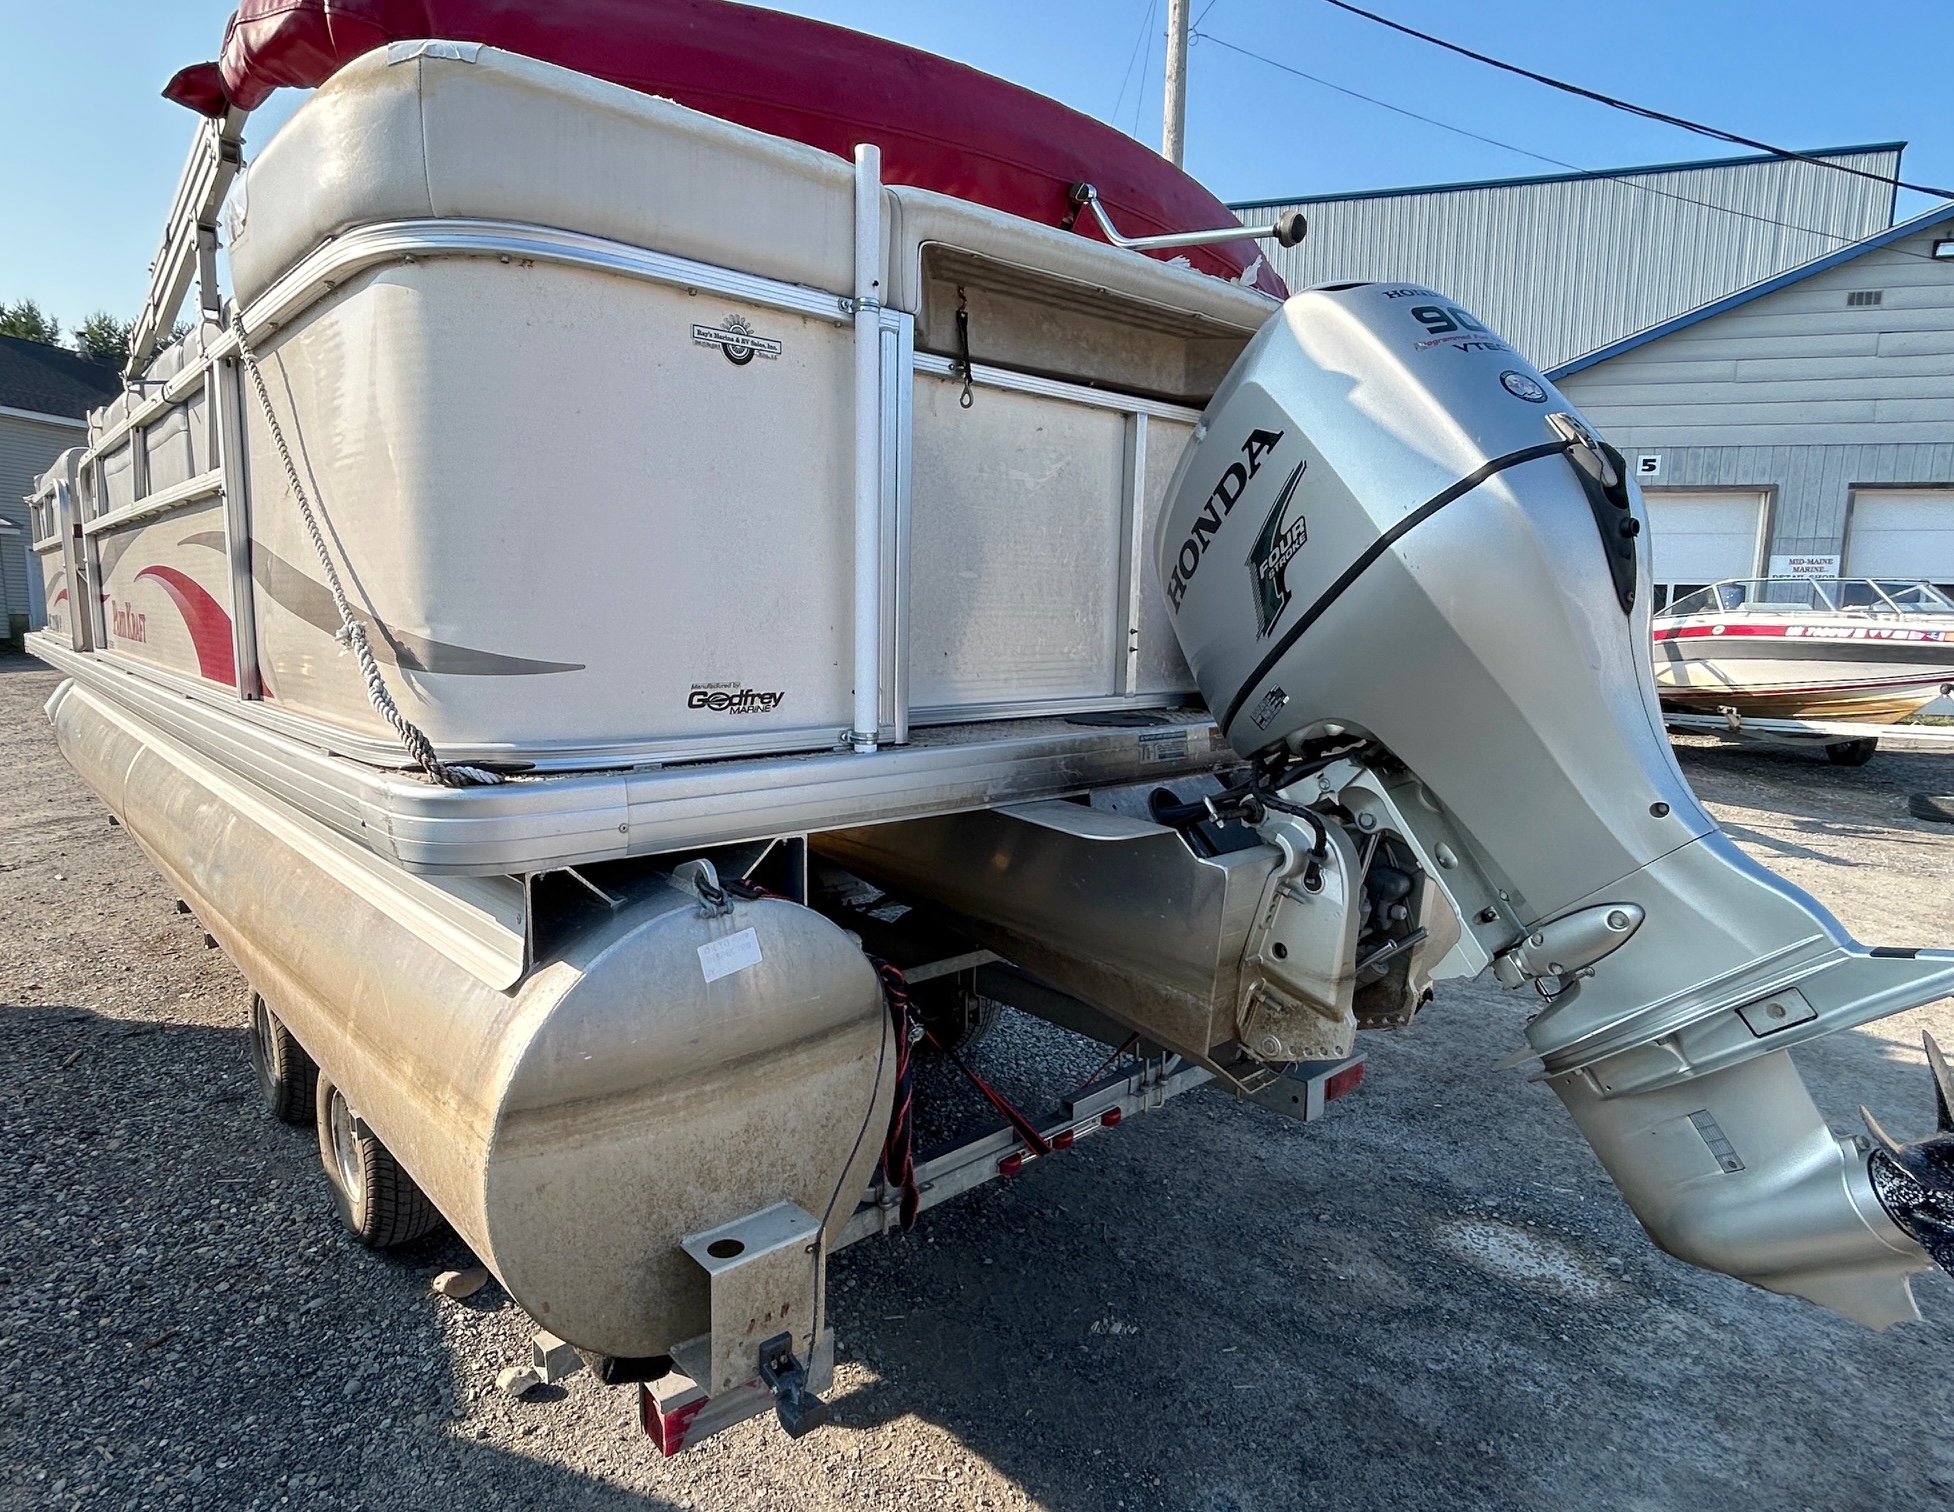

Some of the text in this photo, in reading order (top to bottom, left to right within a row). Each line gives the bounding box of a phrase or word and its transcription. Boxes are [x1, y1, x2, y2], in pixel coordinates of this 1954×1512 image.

[1411, 306, 1490, 334] 90
[1414, 334, 1471, 351] ogrammed
[1452, 342, 1511, 353] VTEC
[1641, 458, 1657, 472] 5
[1167, 428, 1284, 615] HONDA
[1259, 516, 1306, 580] FOUR
[1268, 532, 1306, 580] STROKE
[1789, 558, 1834, 566] MID-MAINE
[687, 688, 786, 712] Godfrey
[729, 704, 772, 715] MARINE
